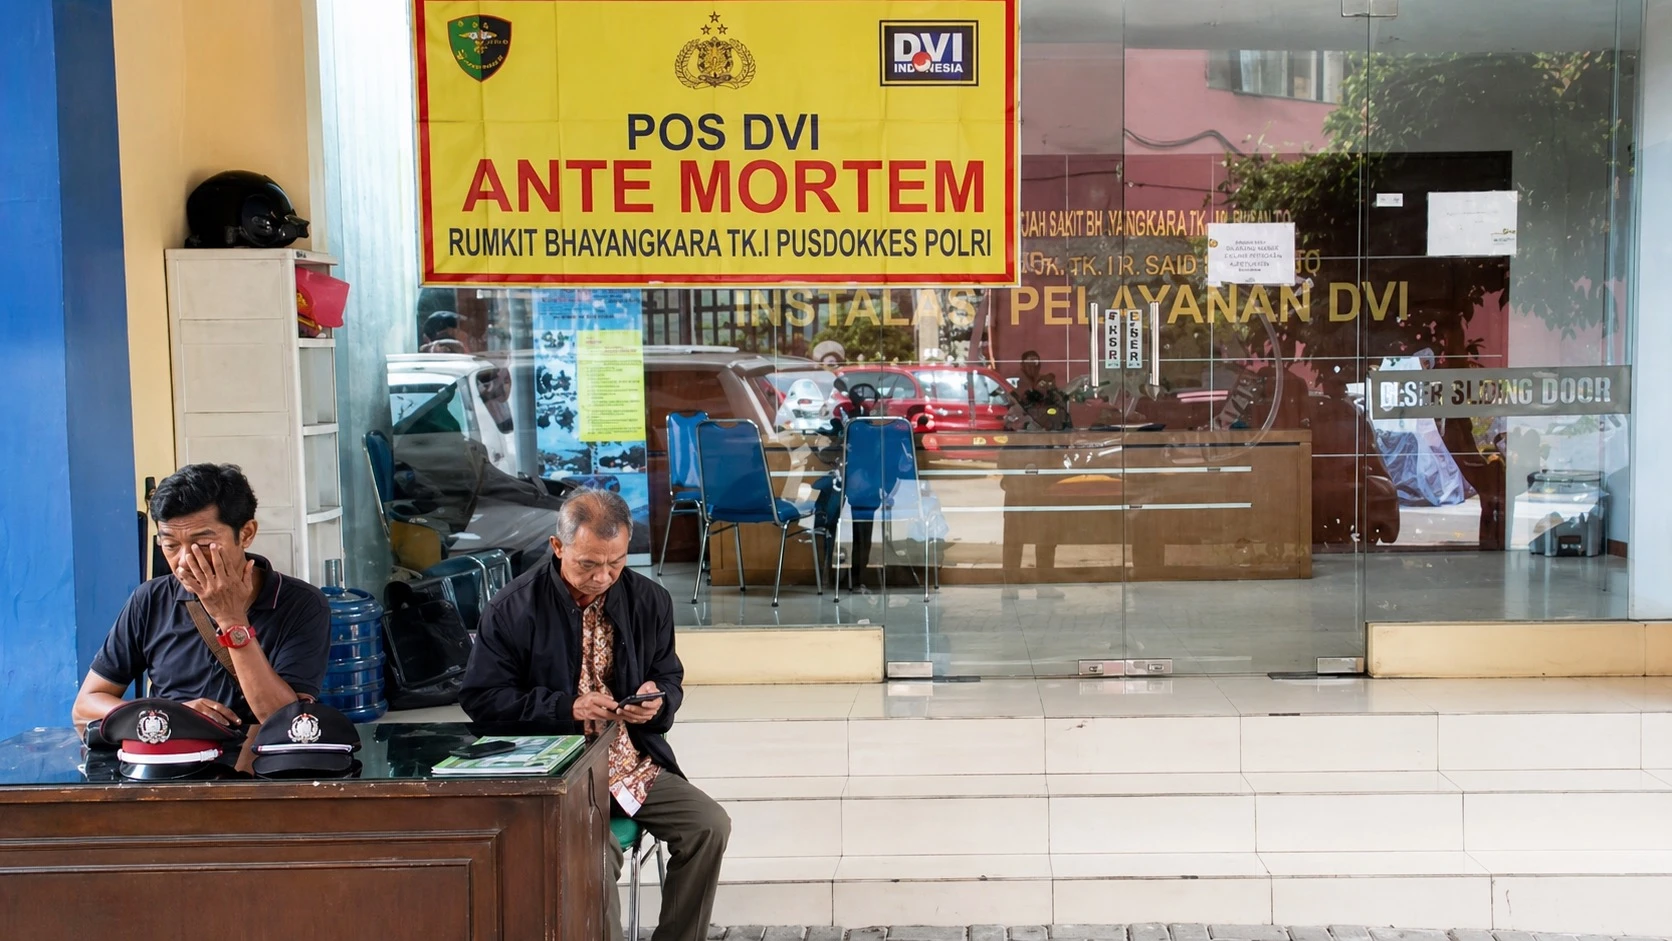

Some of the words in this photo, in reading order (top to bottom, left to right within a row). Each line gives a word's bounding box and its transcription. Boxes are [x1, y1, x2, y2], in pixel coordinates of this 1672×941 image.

[893, 33, 963, 62] DVI
[628, 113, 726, 151] POS
[744, 114, 819, 150] DVI
[462, 159, 654, 213] ANTE
[681, 160, 984, 213] MORTEM
[1049, 210, 1083, 237] SAKIT
[448, 228, 538, 257] RUMKIT
[545, 228, 722, 257] BHAYANGKARA
[727, 228, 769, 257] TK.I
[777, 228, 917, 257] PUSDOKKES
[925, 228, 992, 257] POLRI
[1145, 254, 1197, 276] SAID
[1010, 284, 1311, 325] PELAYANAN
[1328, 281, 1410, 322] DVI
[1451, 378, 1533, 405] SLIDING
[1542, 376, 1611, 404] DOOR
